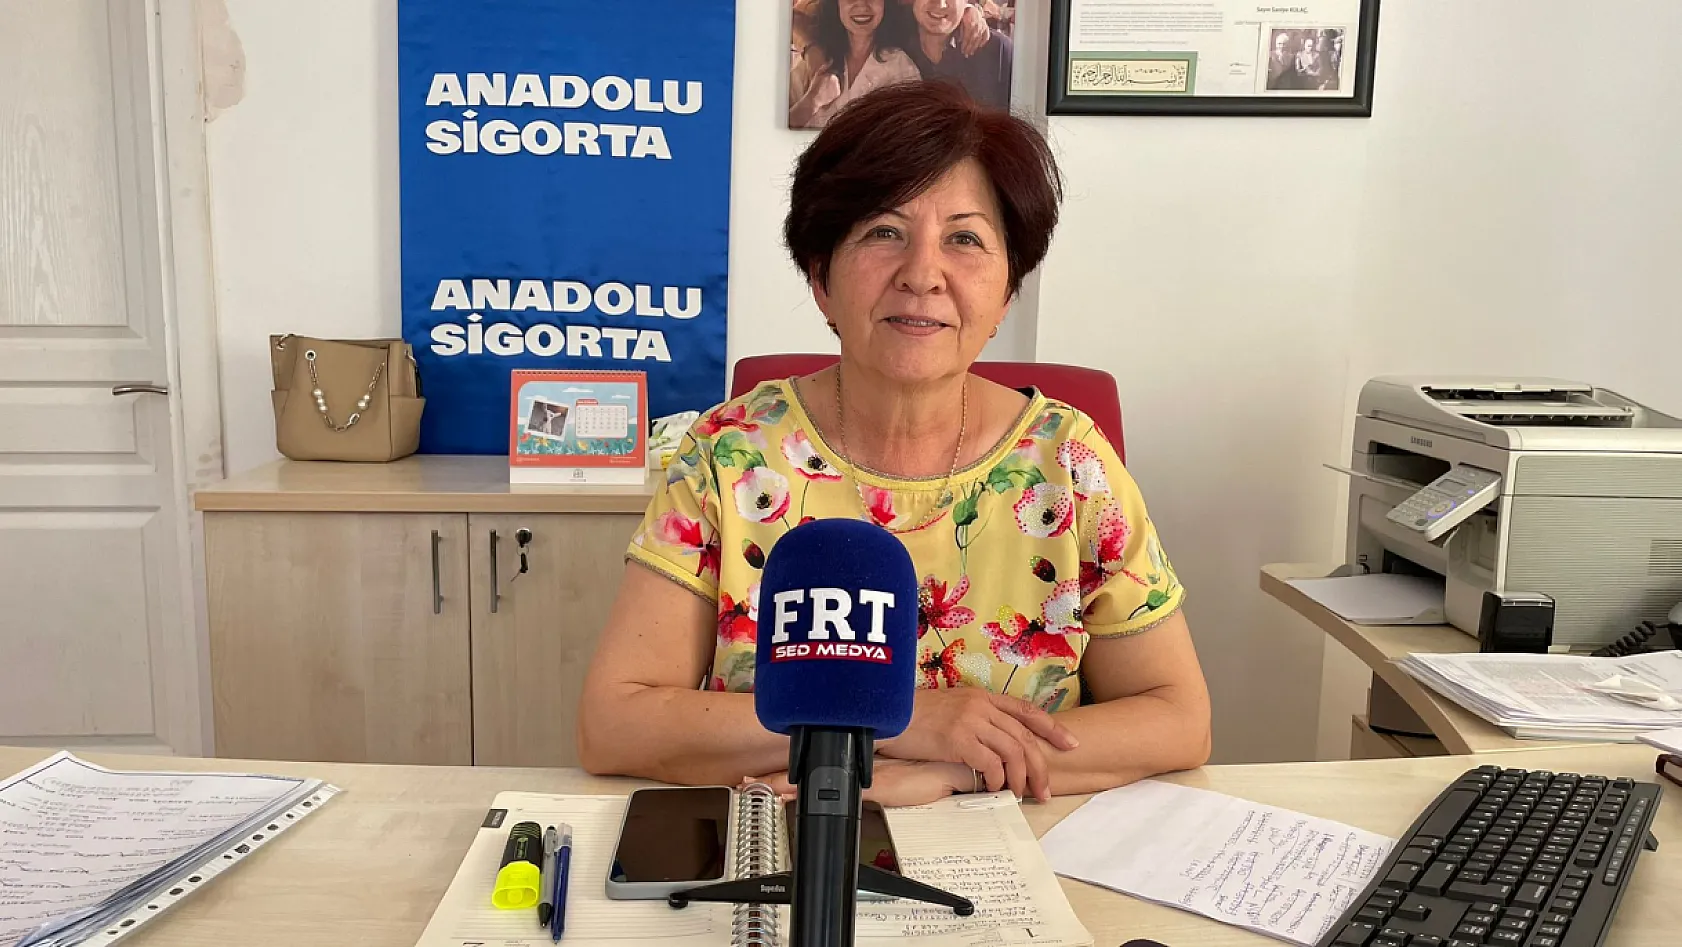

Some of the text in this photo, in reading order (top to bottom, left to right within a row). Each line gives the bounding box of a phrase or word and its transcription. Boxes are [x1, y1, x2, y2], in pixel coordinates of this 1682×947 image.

[425, 72, 703, 114] ANADOLU
[425, 108, 672, 160] SİGORTA
[430, 278, 703, 320] ANADOLU
[430, 312, 672, 362] SİGORTA
[771, 587, 895, 644] FRT
[775, 644, 887, 660] SED MEDYA
